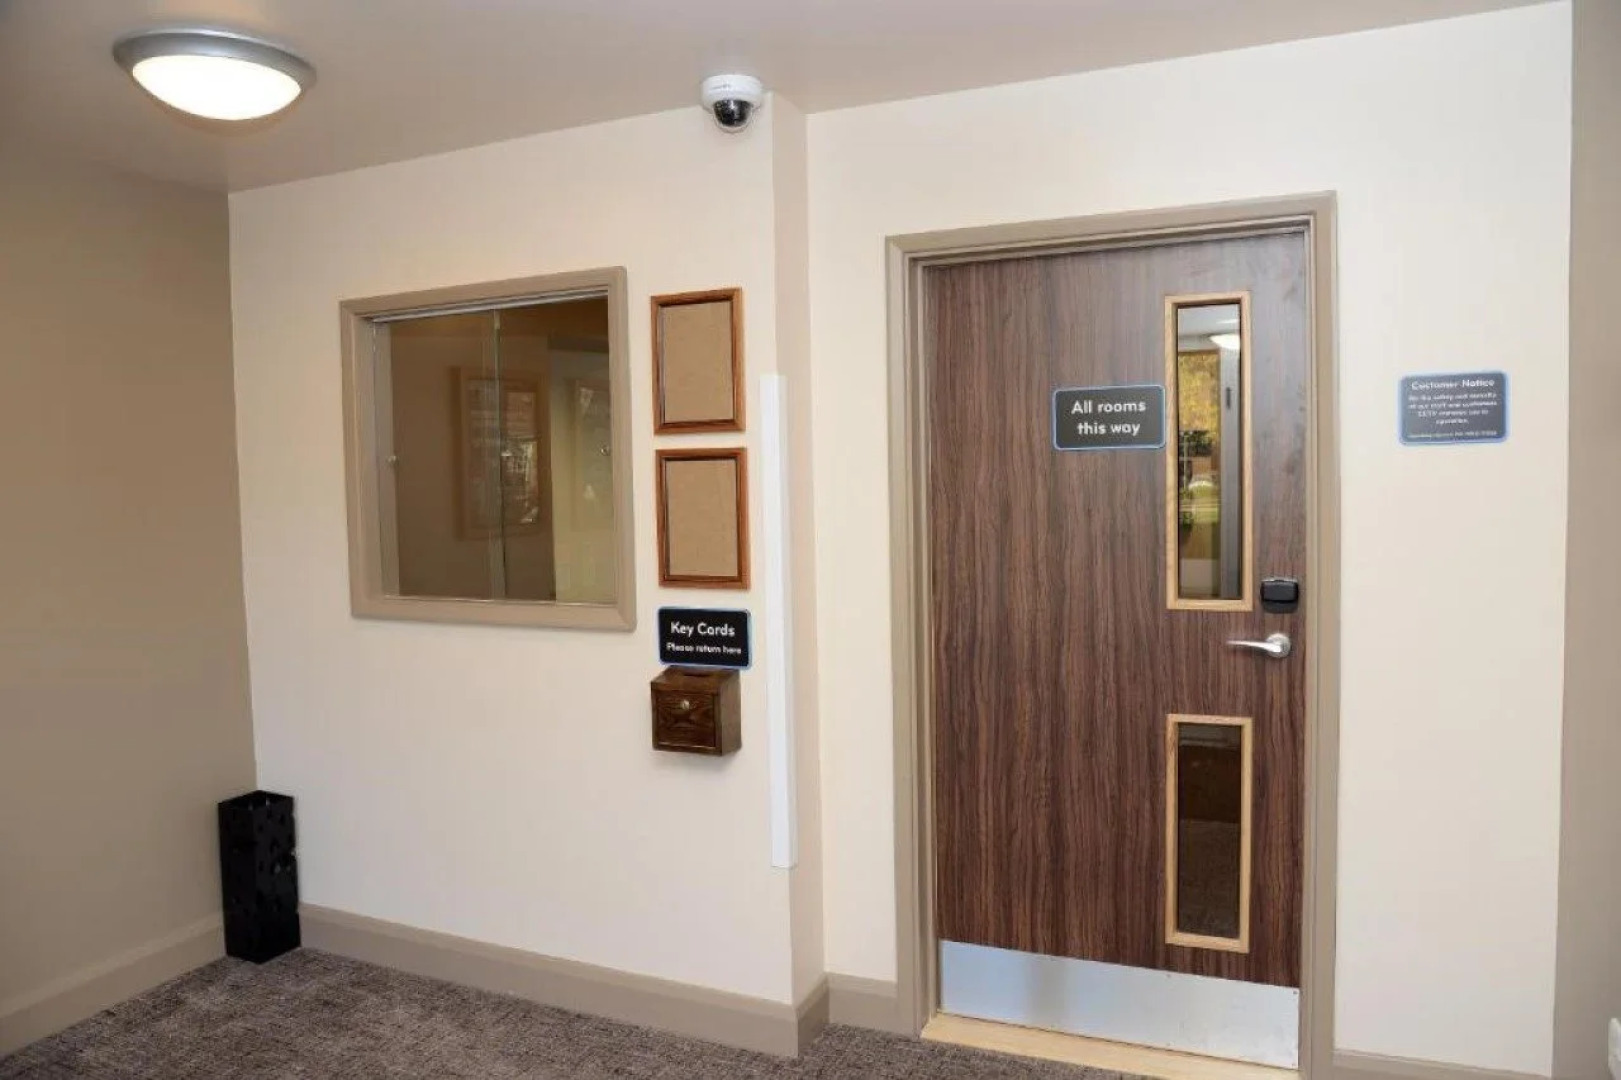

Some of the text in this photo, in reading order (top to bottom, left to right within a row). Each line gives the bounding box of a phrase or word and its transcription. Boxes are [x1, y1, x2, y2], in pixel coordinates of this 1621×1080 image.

[1411, 379, 1495, 391] Customer Notice
[1071, 400, 1147, 414] All rooms
[1077, 421, 1141, 437] this way
[670, 621, 736, 637] Key Cards
[665, 642, 742, 655] Please return here
